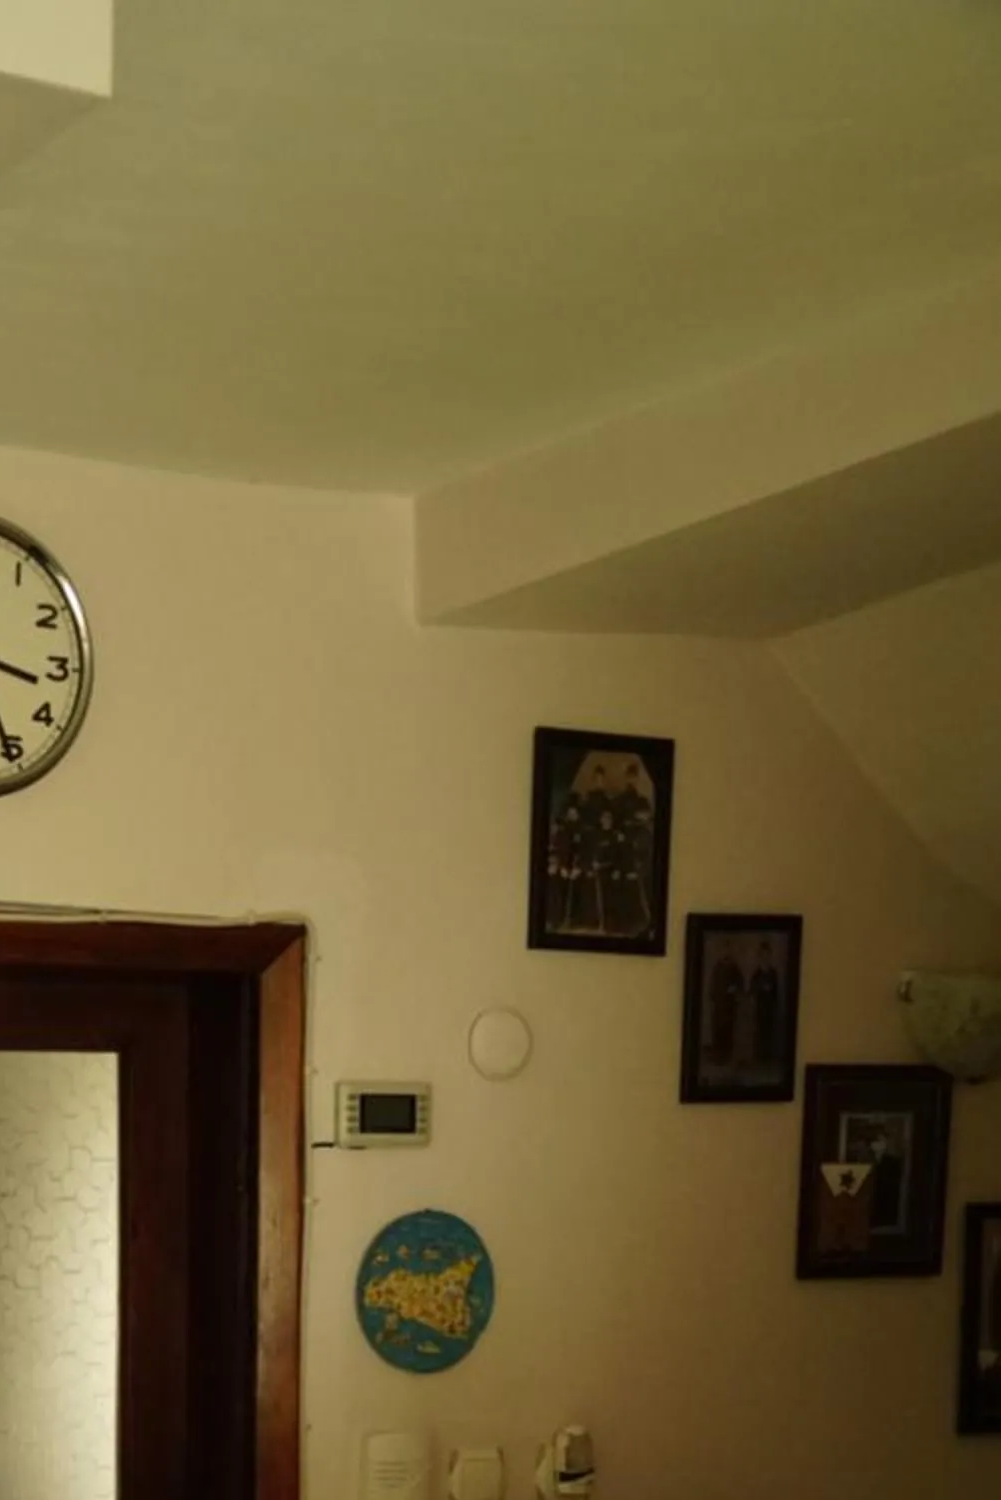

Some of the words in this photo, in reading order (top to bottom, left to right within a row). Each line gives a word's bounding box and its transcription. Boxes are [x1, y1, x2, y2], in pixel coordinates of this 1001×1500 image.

[15, 561, 22, 587] 1
[36, 604, 58, 629] 2
[46, 656, 69, 682] 3
[32, 702, 54, 727] 4
[0, 735, 24, 762] 5
